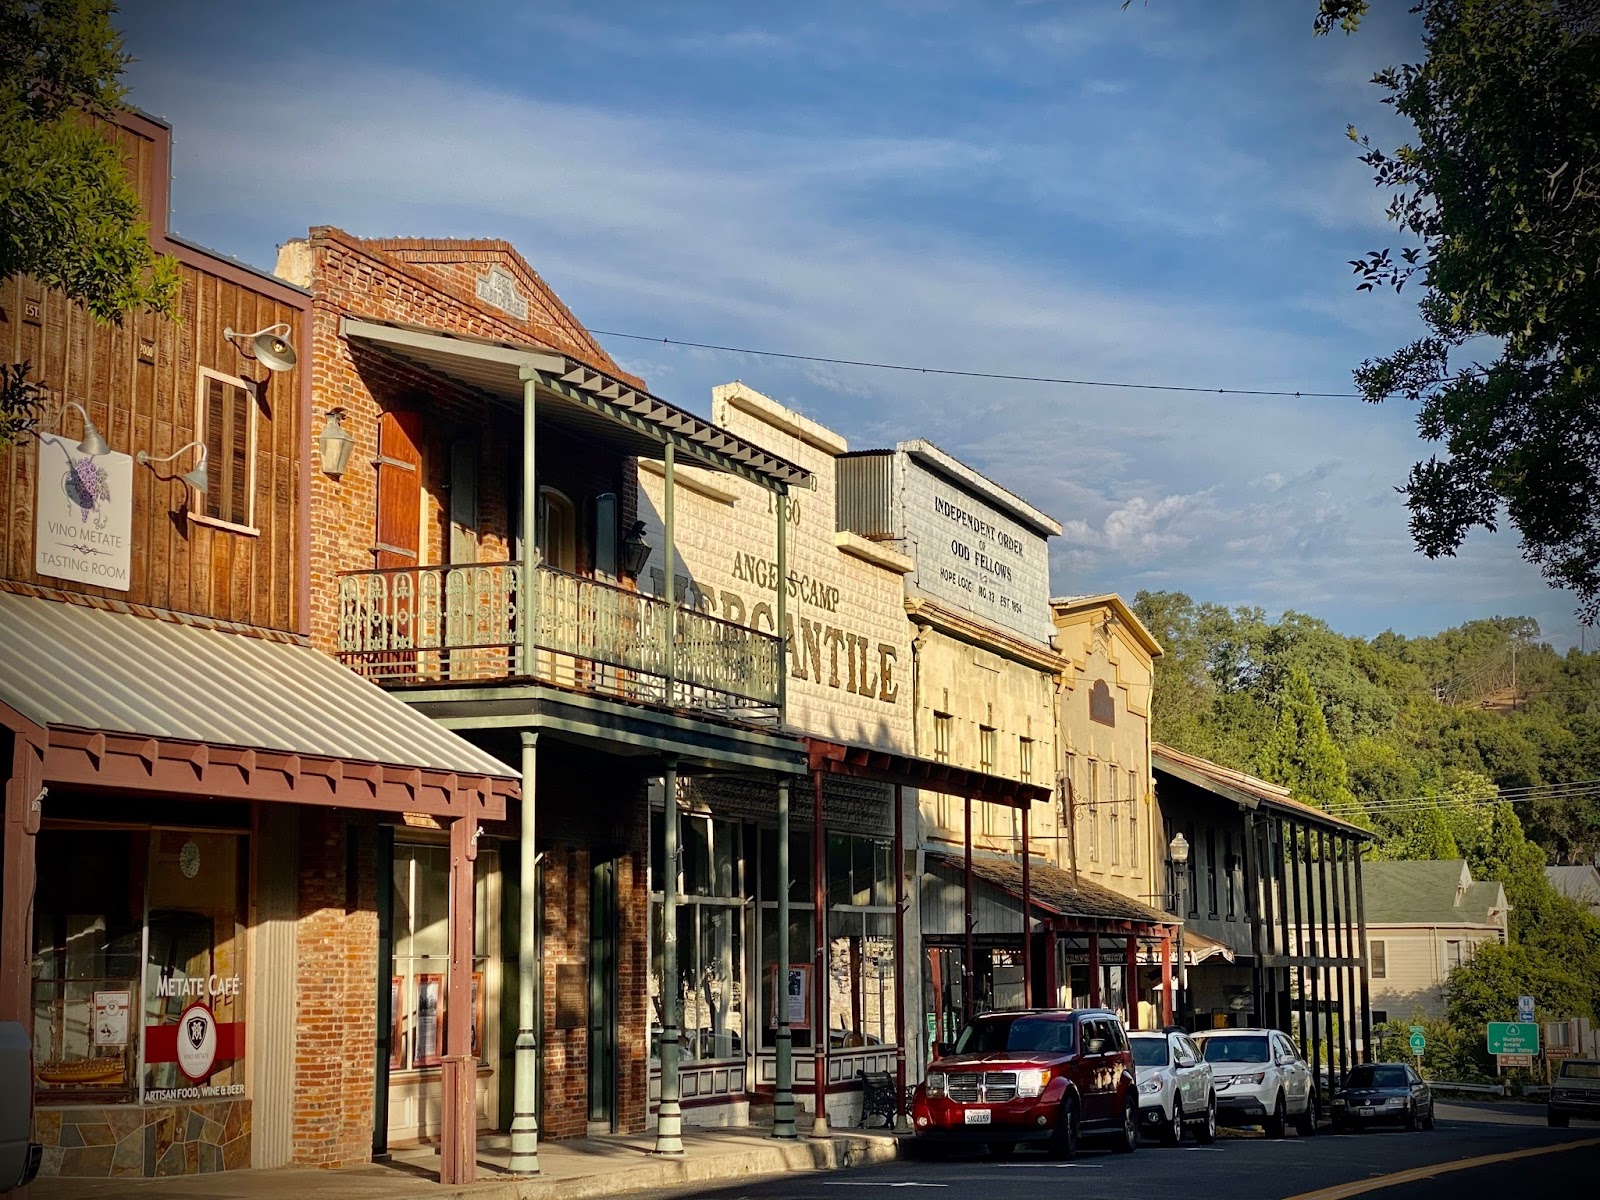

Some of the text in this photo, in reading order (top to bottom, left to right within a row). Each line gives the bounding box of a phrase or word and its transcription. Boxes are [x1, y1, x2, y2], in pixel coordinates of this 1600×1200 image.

[767, 488, 801, 526] 160
[47, 521, 122, 548] VINO METATE
[935, 496, 1024, 557] INDEPENDENT ORDER
[41, 551, 126, 580] TASTING ROOM
[951, 540, 1012, 582] ODD FELLOWS
[731, 550, 840, 614] ANGES CAMP
[940, 566, 956, 585] HOPE
[156, 973, 240, 997] METATE CAFÉ
[1414, 1038, 1421, 1046] 4
[144, 1084, 245, 1102] ARTISAN FOOD, WINE & BEER
